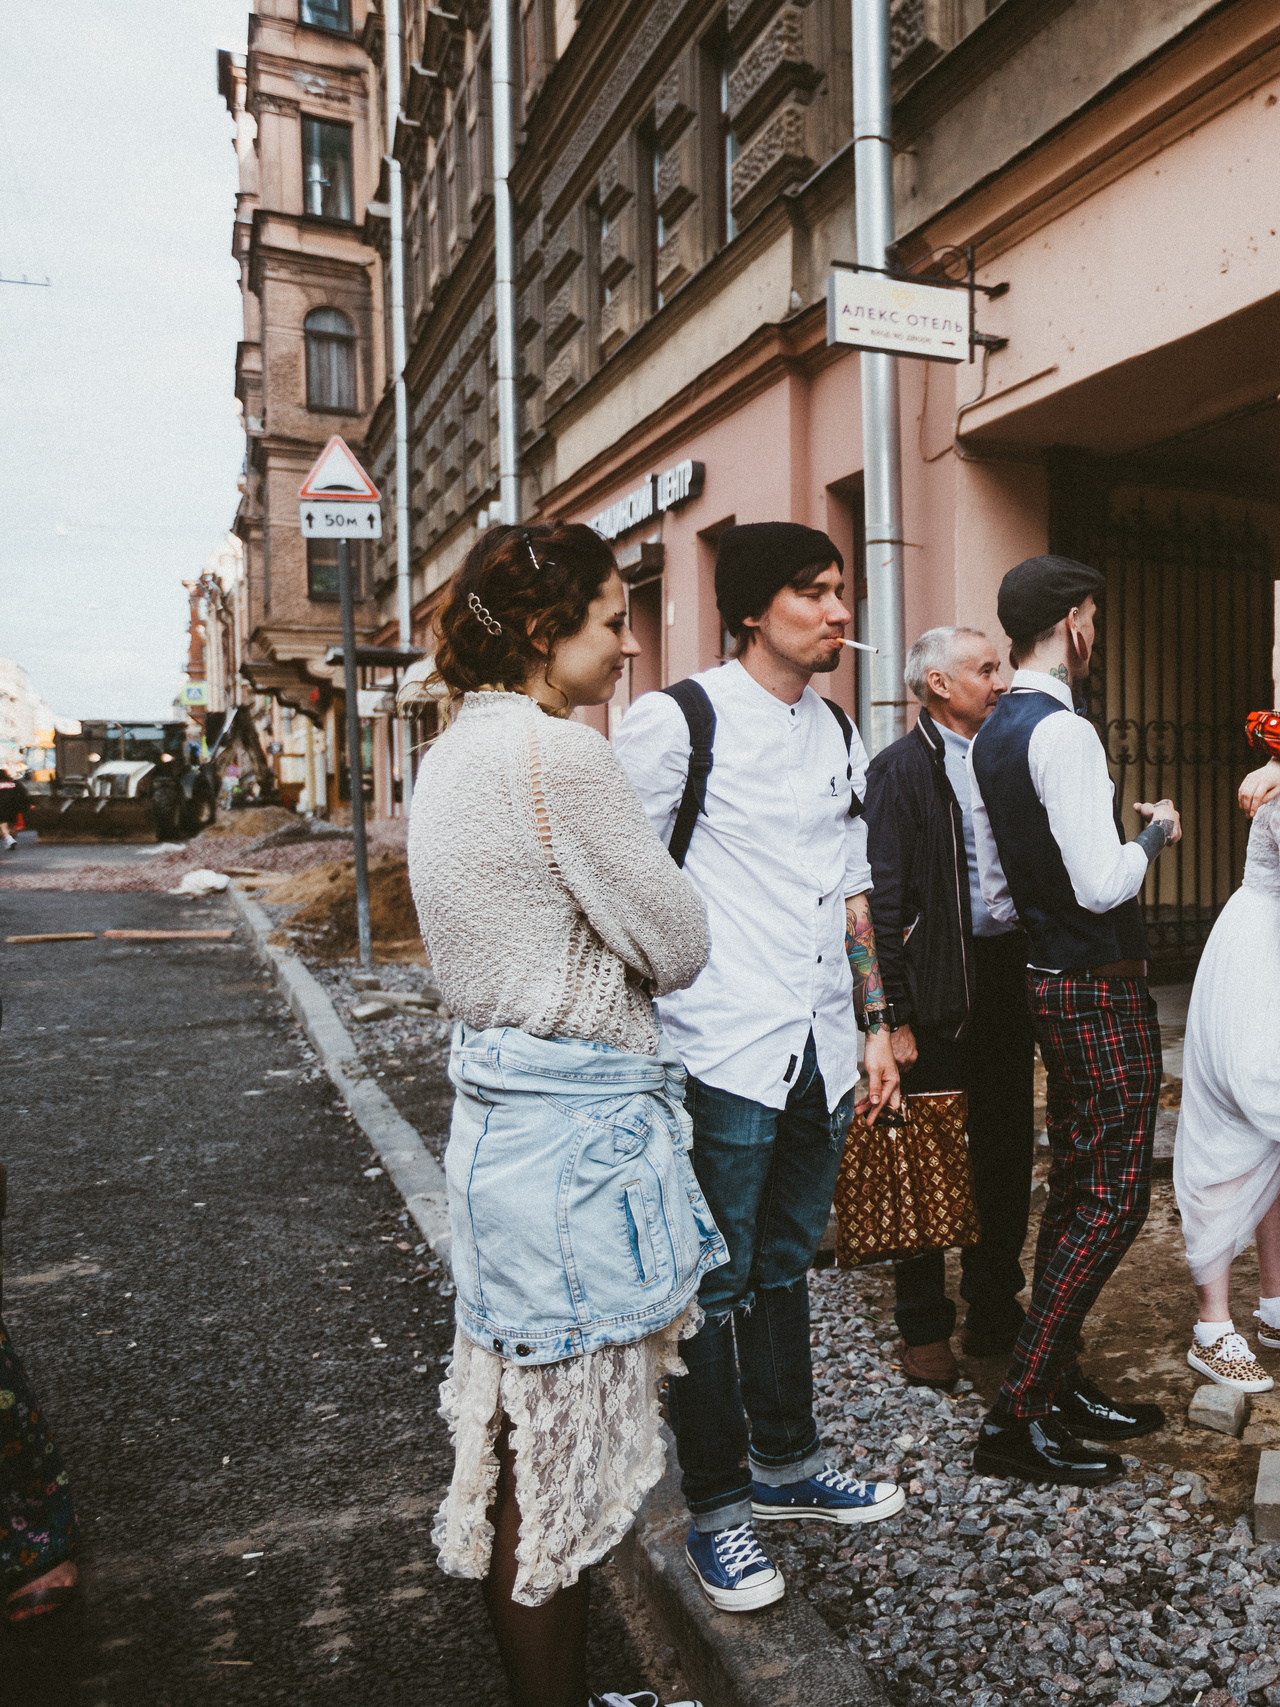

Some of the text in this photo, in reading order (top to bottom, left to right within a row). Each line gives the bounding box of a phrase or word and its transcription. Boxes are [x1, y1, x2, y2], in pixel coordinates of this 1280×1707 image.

[842, 304, 963, 333] АЛЕКС ОТЕЛЬ
[657, 458, 693, 512] ЦЕНТР
